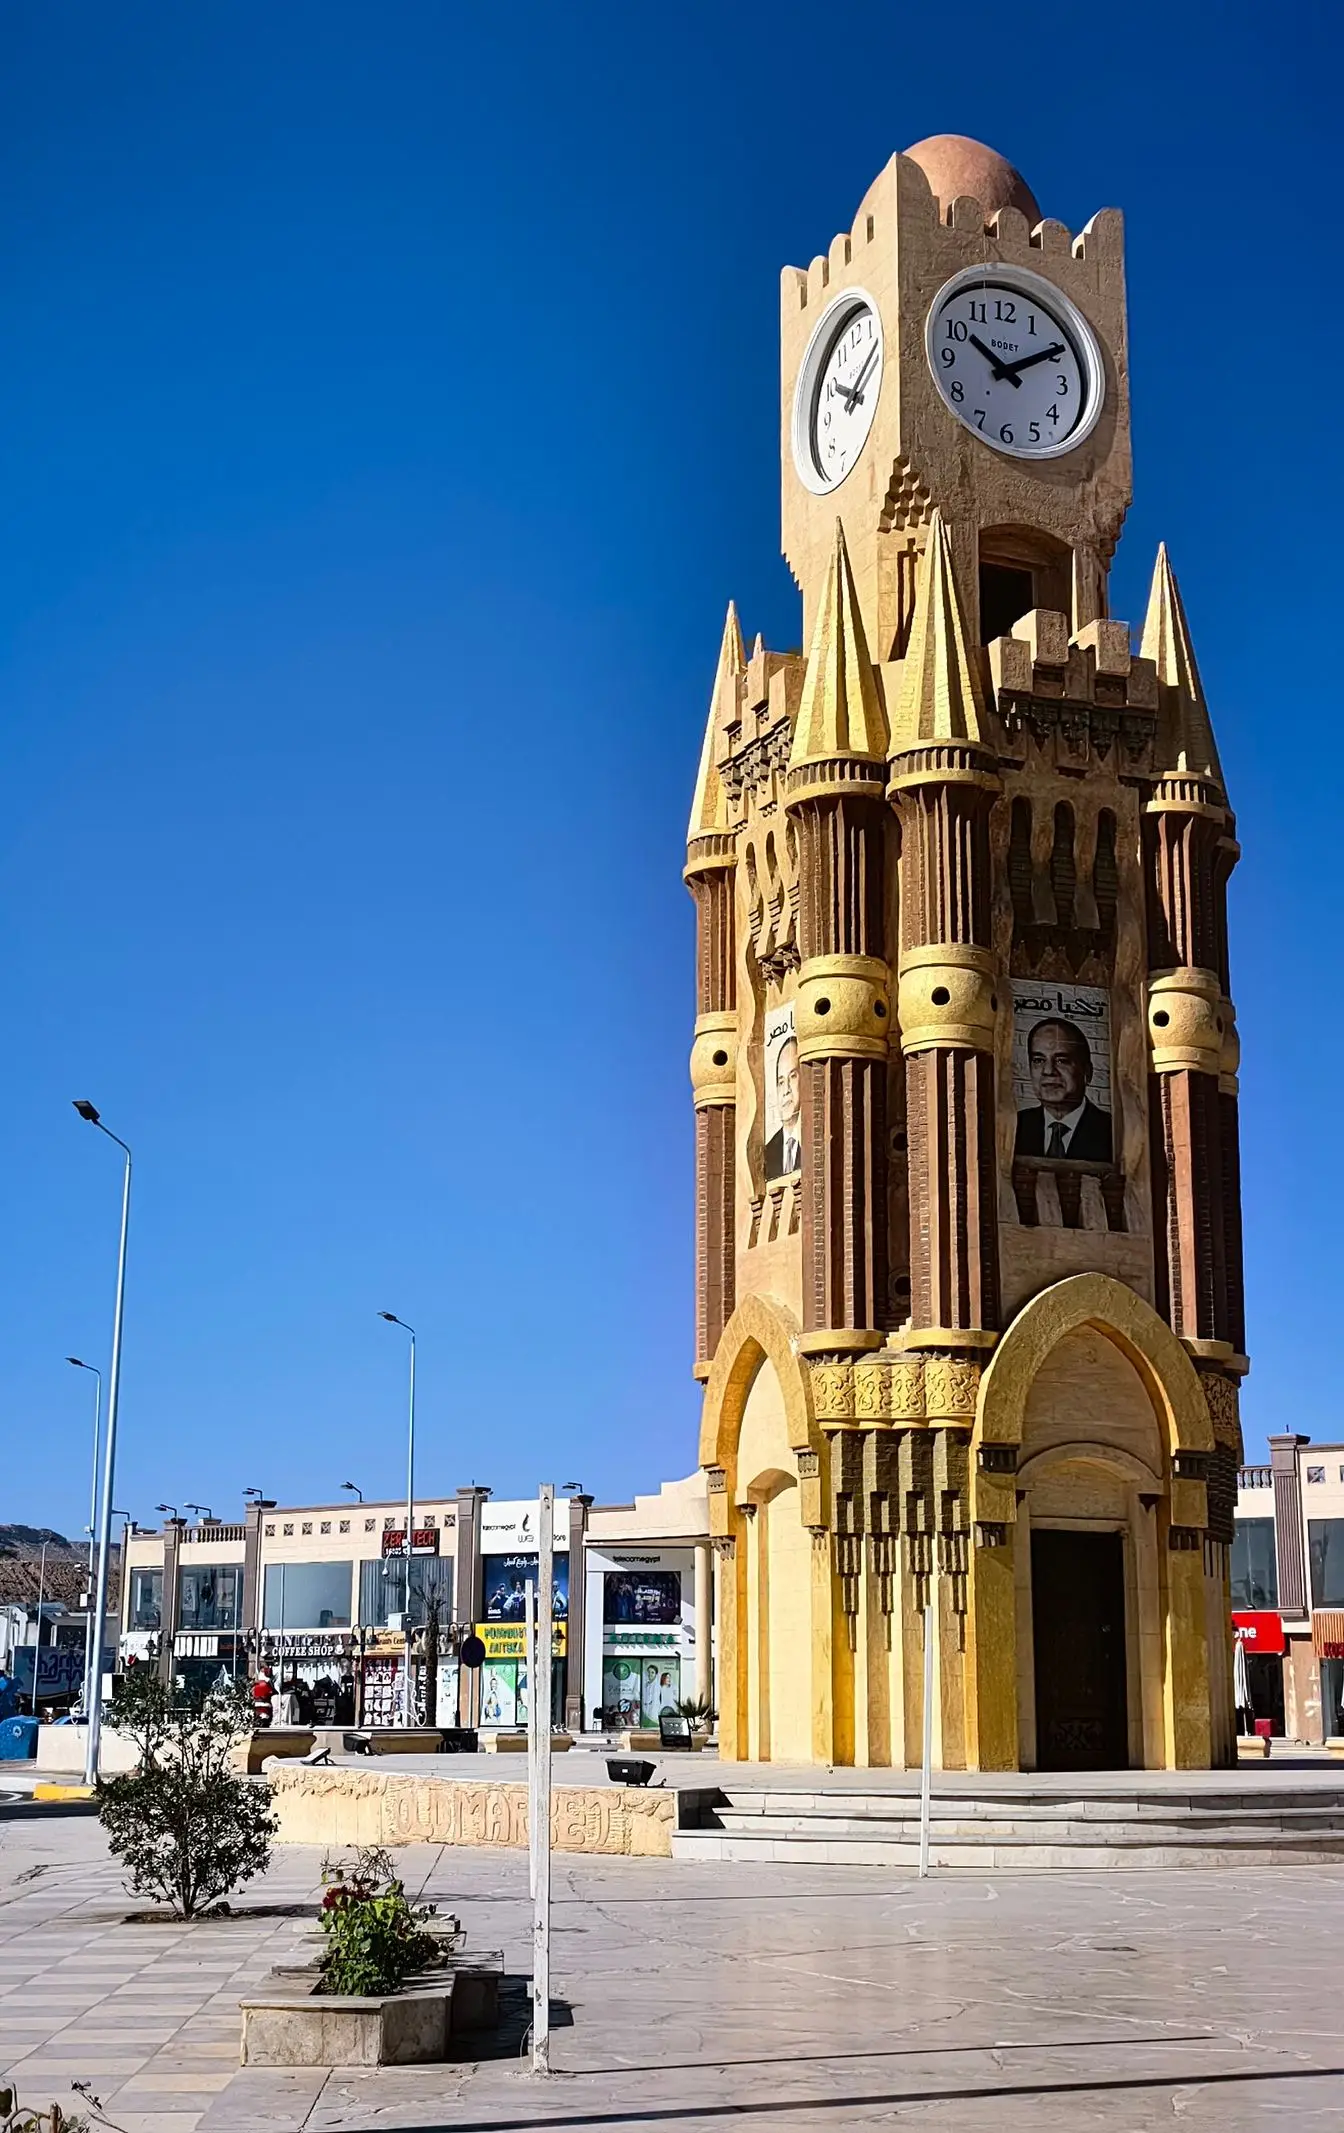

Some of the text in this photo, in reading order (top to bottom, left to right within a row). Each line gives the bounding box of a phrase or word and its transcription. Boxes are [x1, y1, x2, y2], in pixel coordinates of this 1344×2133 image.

[969, 301, 987, 324] 11
[994, 300, 1017, 323] 12
[851, 323, 862, 349] 12
[945, 319, 968, 342] 10
[1028, 315, 1037, 336] 1
[837, 344, 847, 368] 11
[991, 339, 1019, 352] BODET
[941, 347, 956, 368] 9
[825, 376, 838, 403] 10
[950, 381, 965, 403] 8
[1056, 375, 1068, 396] 3
[823, 411, 832, 433] 9
[973, 409, 987, 431] 7
[1046, 403, 1060, 426] 4
[999, 423, 1014, 444] 6
[1028, 422, 1041, 442] 5
[1057, 991, 1109, 1019] تحيا
[766, 1022, 789, 1047] مصر
[272, 1645, 334, 1656] COFFEE SHOP
[397, 1787, 452, 1839] OLD
